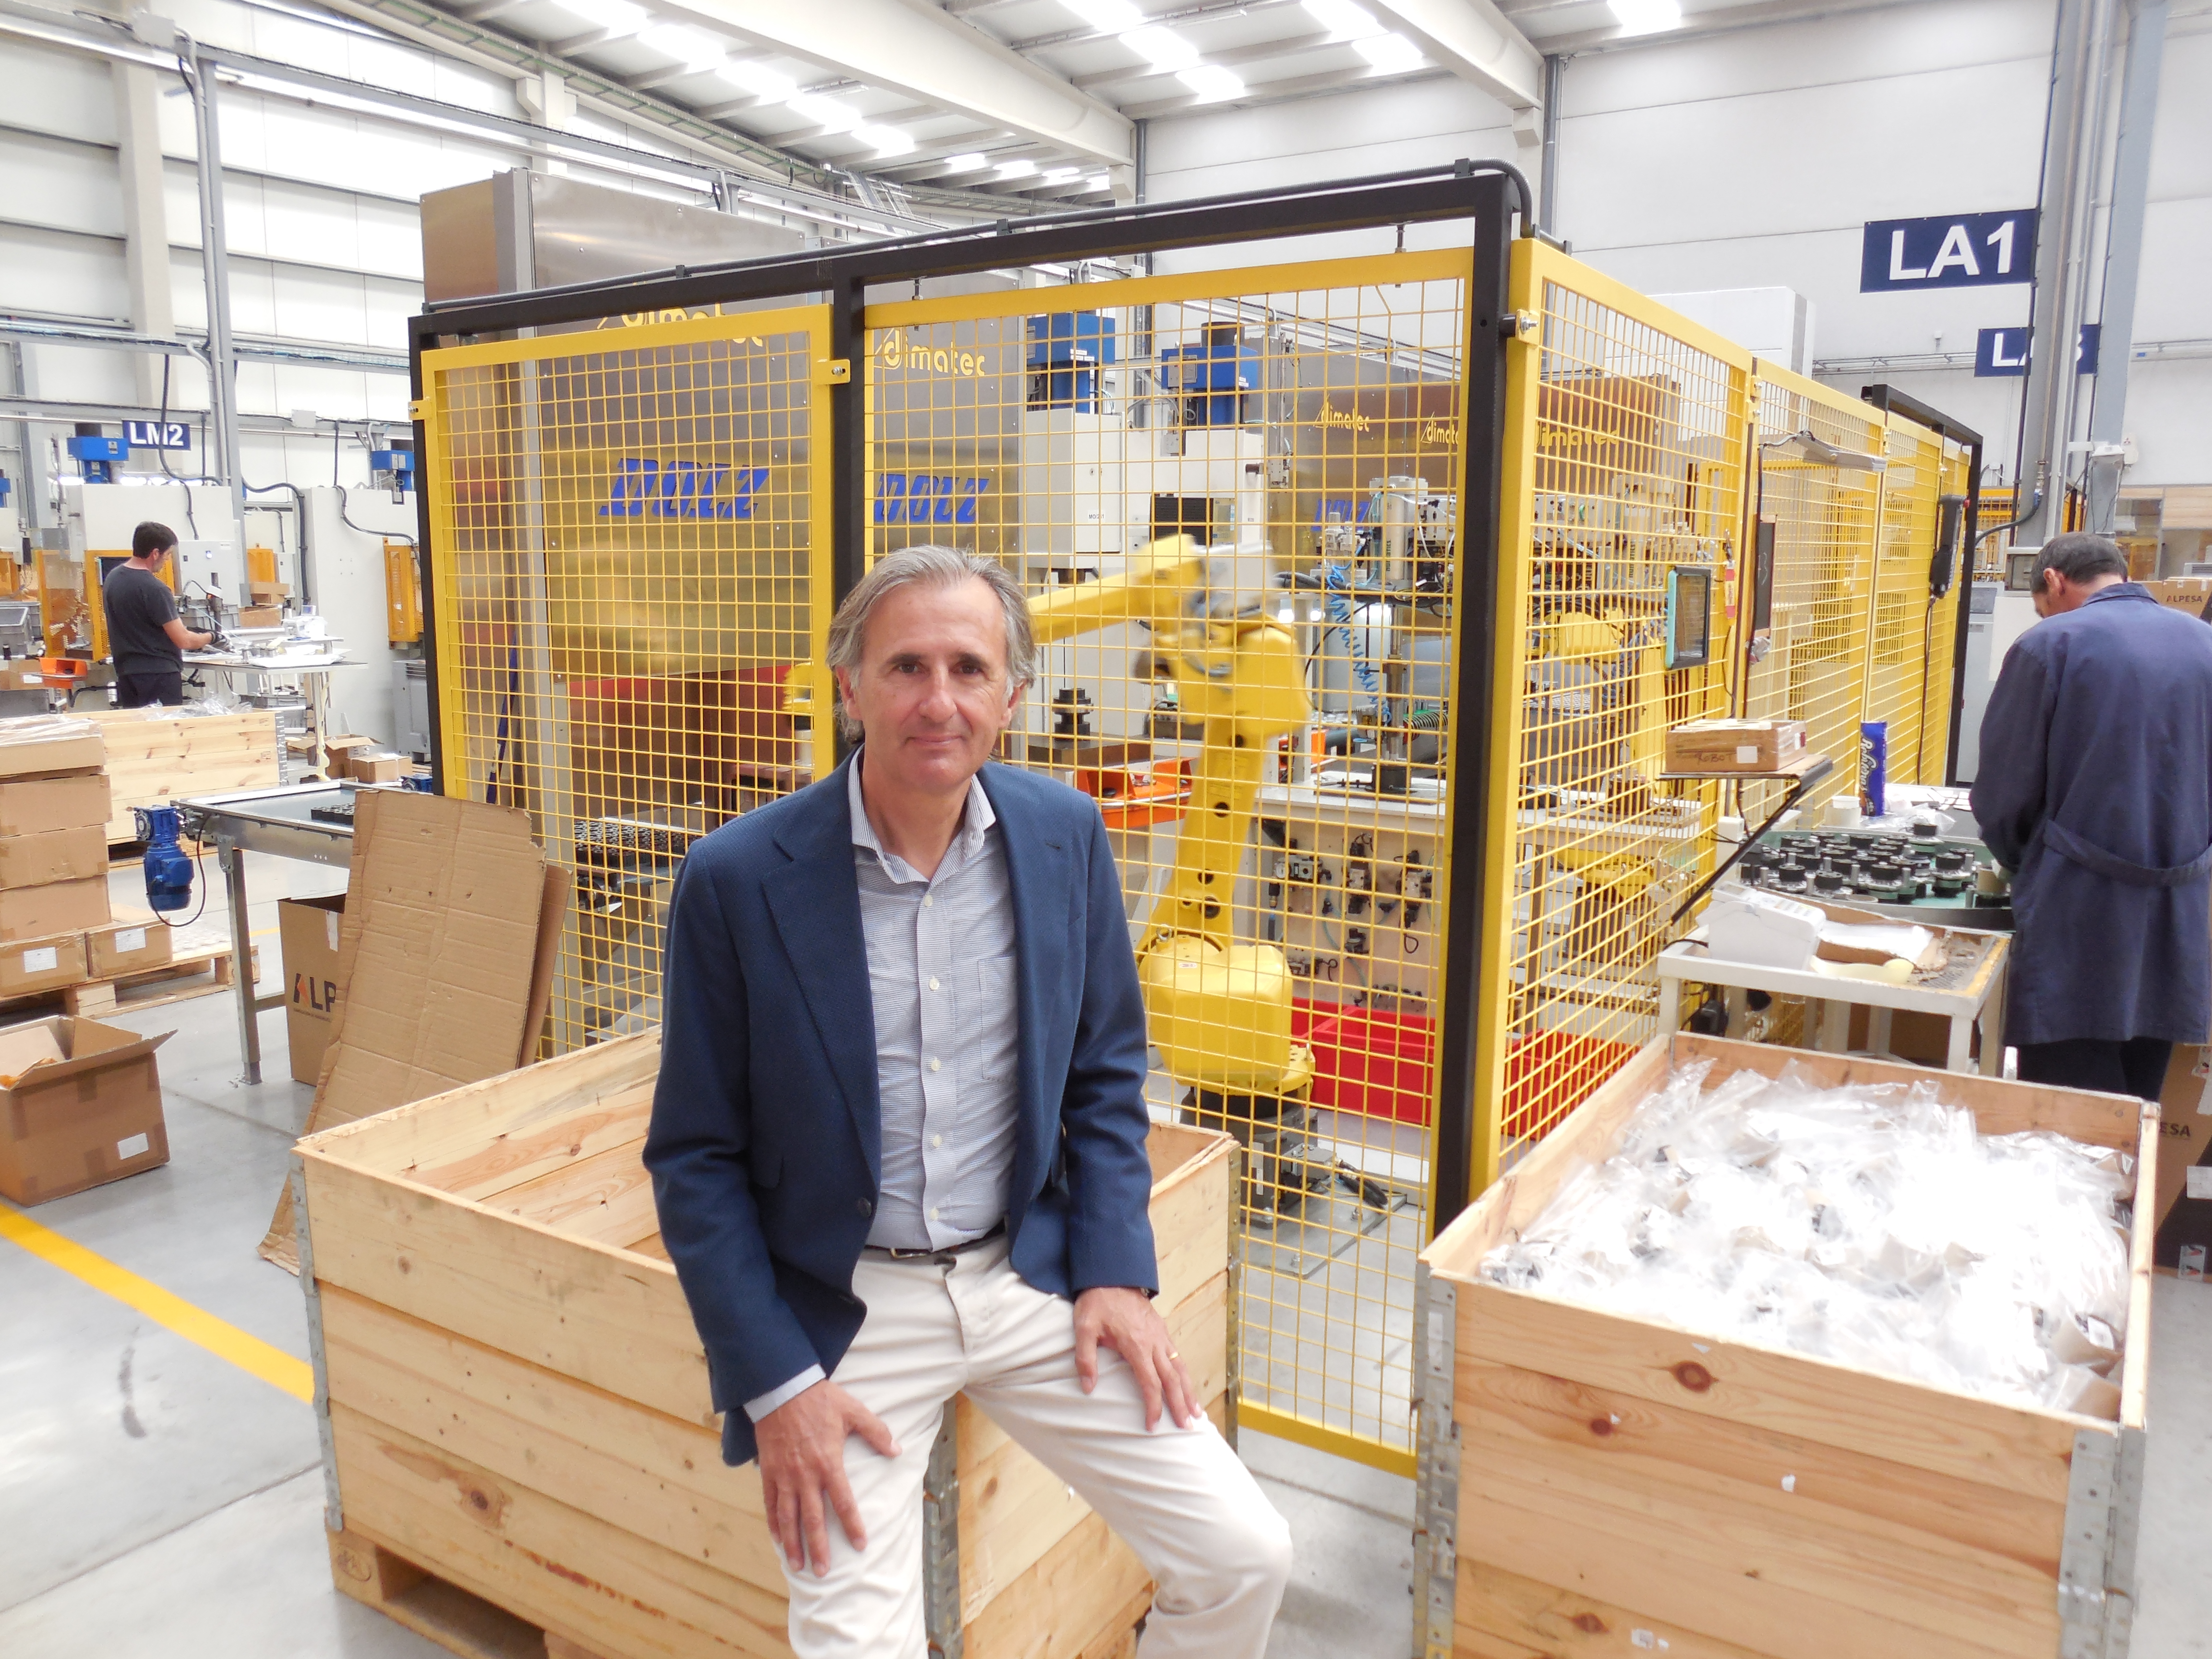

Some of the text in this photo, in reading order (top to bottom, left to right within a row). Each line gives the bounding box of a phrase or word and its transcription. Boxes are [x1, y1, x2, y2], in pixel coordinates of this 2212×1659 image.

[1889, 220, 2015, 281] LA1
[884, 329, 986, 376] dimatec
[130, 421, 184, 446] LM2
[1321, 399, 1370, 432] dimatec
[598, 457, 769, 518] DOLZ
[875, 473, 990, 523] DOLZ
